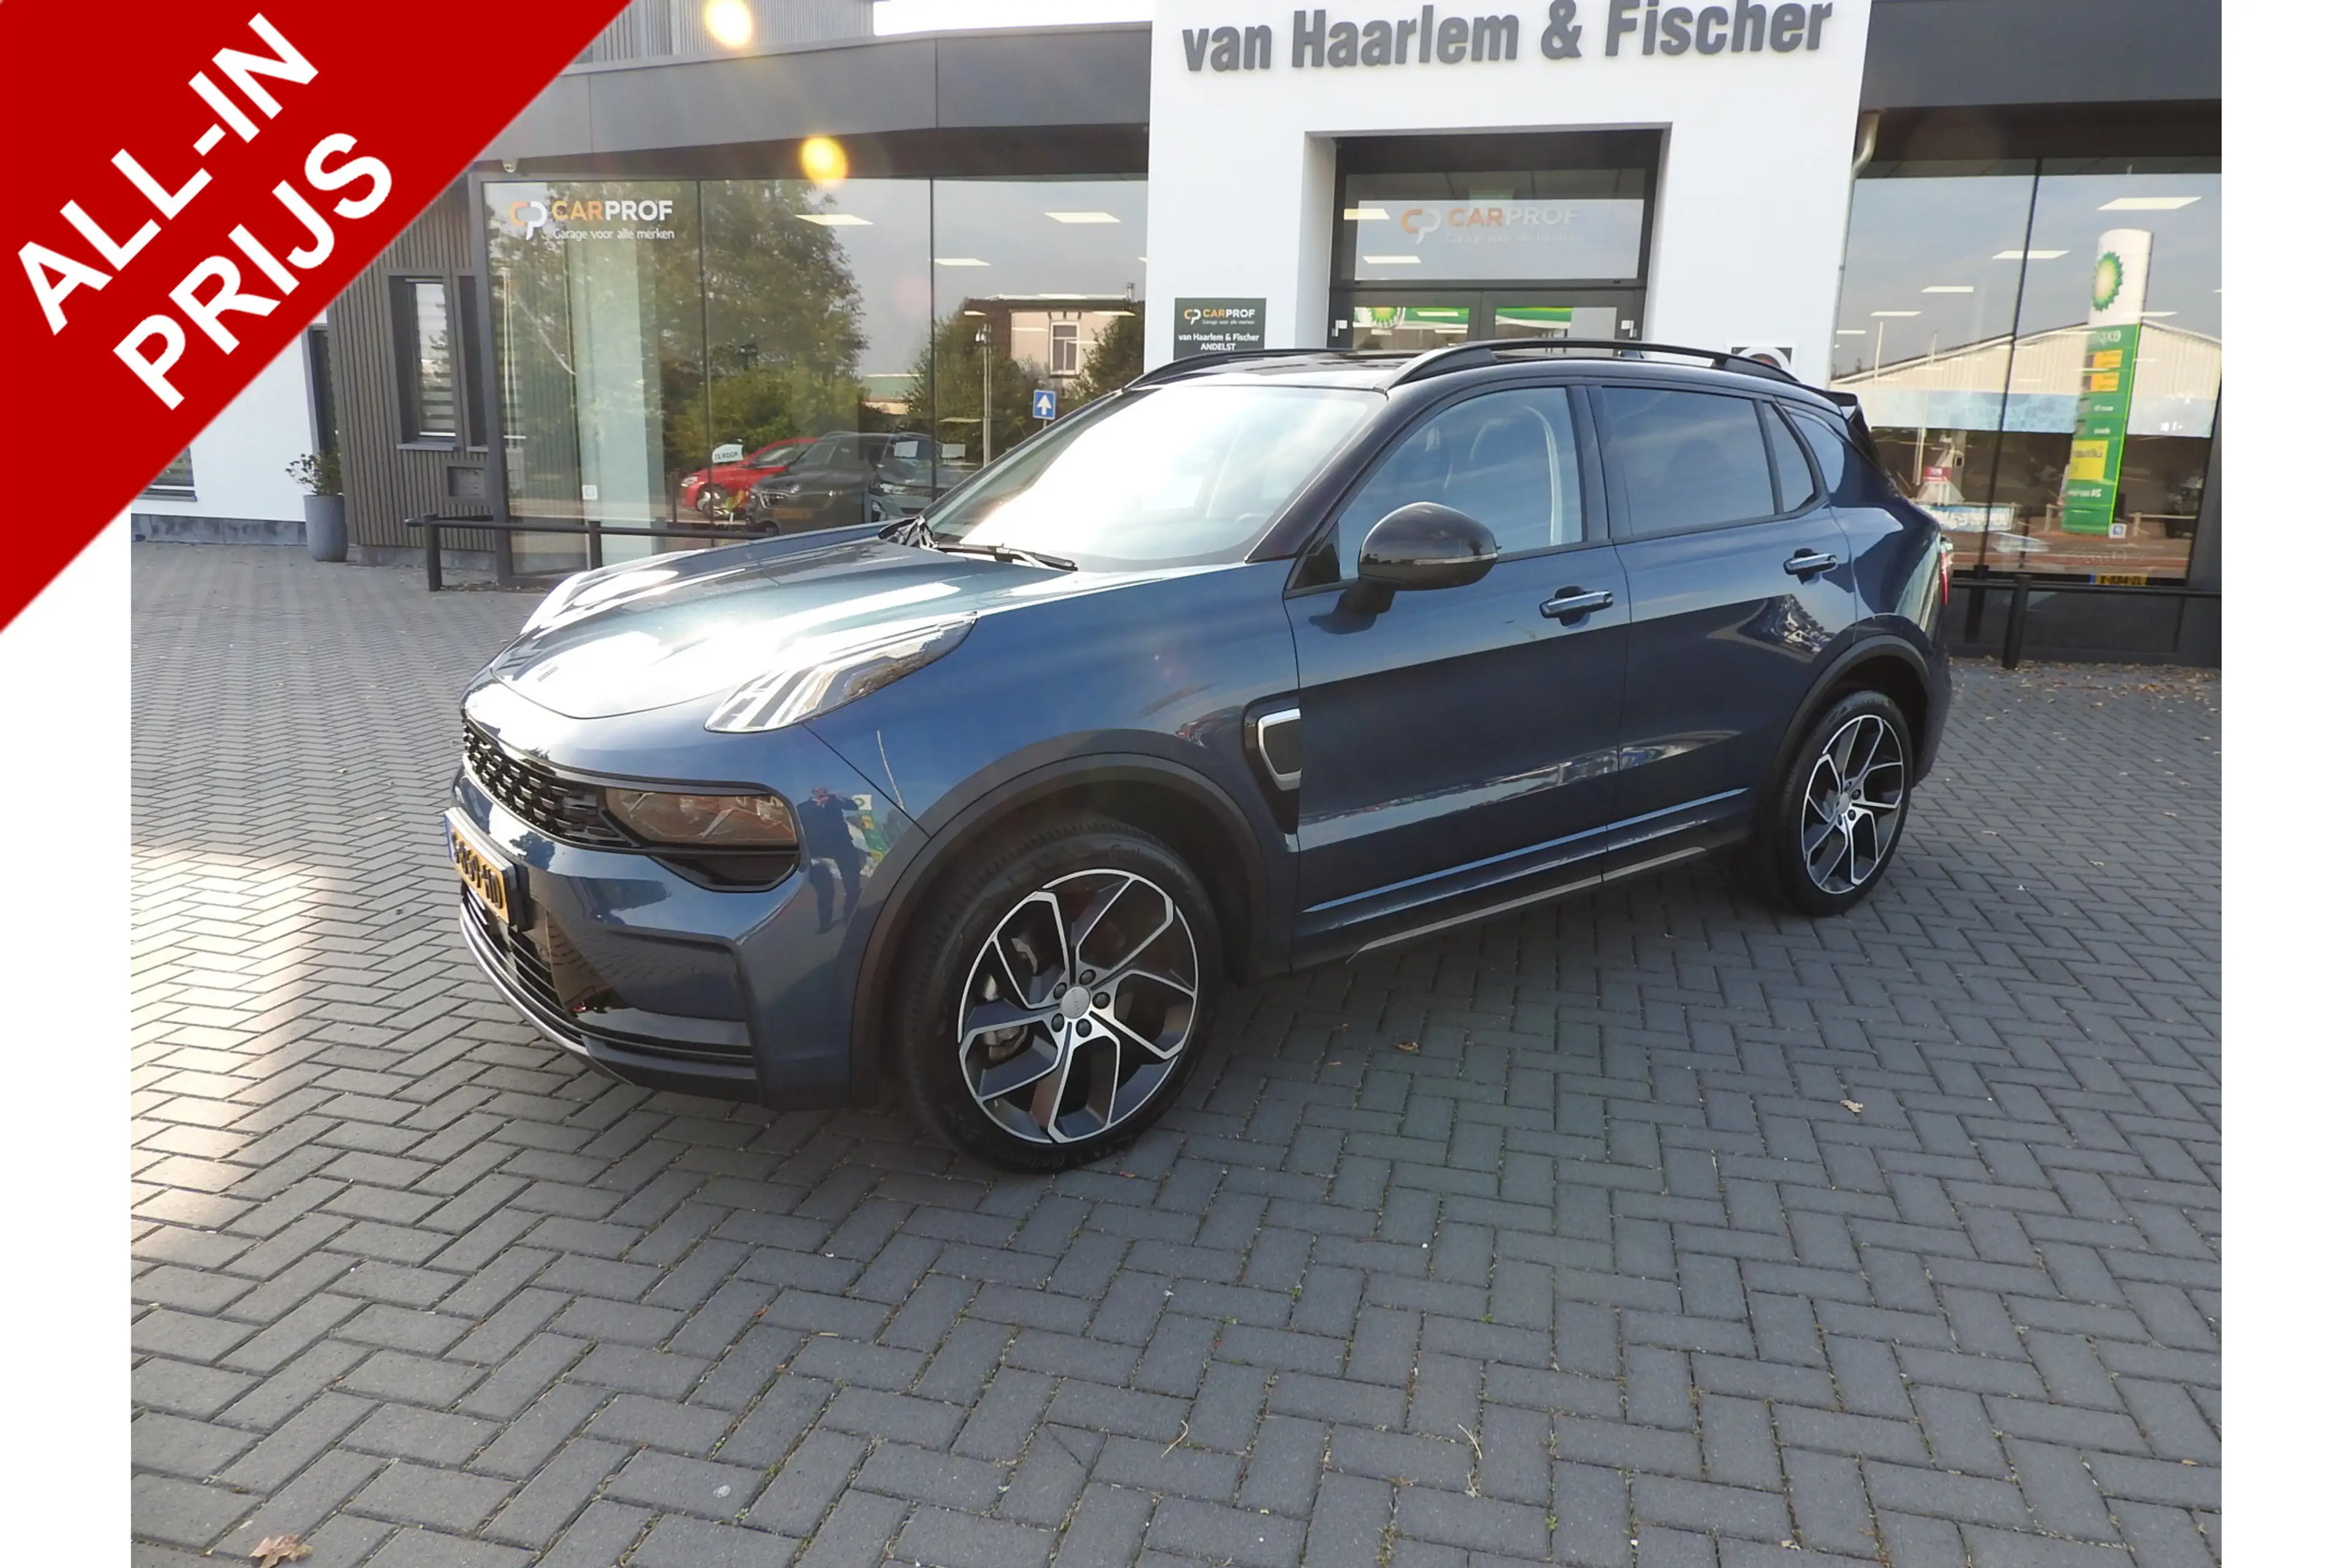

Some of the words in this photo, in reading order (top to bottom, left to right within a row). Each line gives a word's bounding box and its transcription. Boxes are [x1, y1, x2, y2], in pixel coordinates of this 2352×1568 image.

[1182, 24, 1272, 72] van
[1292, 4, 1520, 69] Haarlem
[1540, 0, 1583, 61] &
[1605, 0, 1834, 58] Fischer
[552, 200, 673, 221] CARPROF
[1447, 206, 1580, 227] CARPROF
[552, 228, 588, 241] Garage
[617, 228, 634, 239] alle
[636, 228, 675, 239] merken
[1202, 309, 1256, 318] CARPROF
[1233, 333, 1259, 342] Fischer
